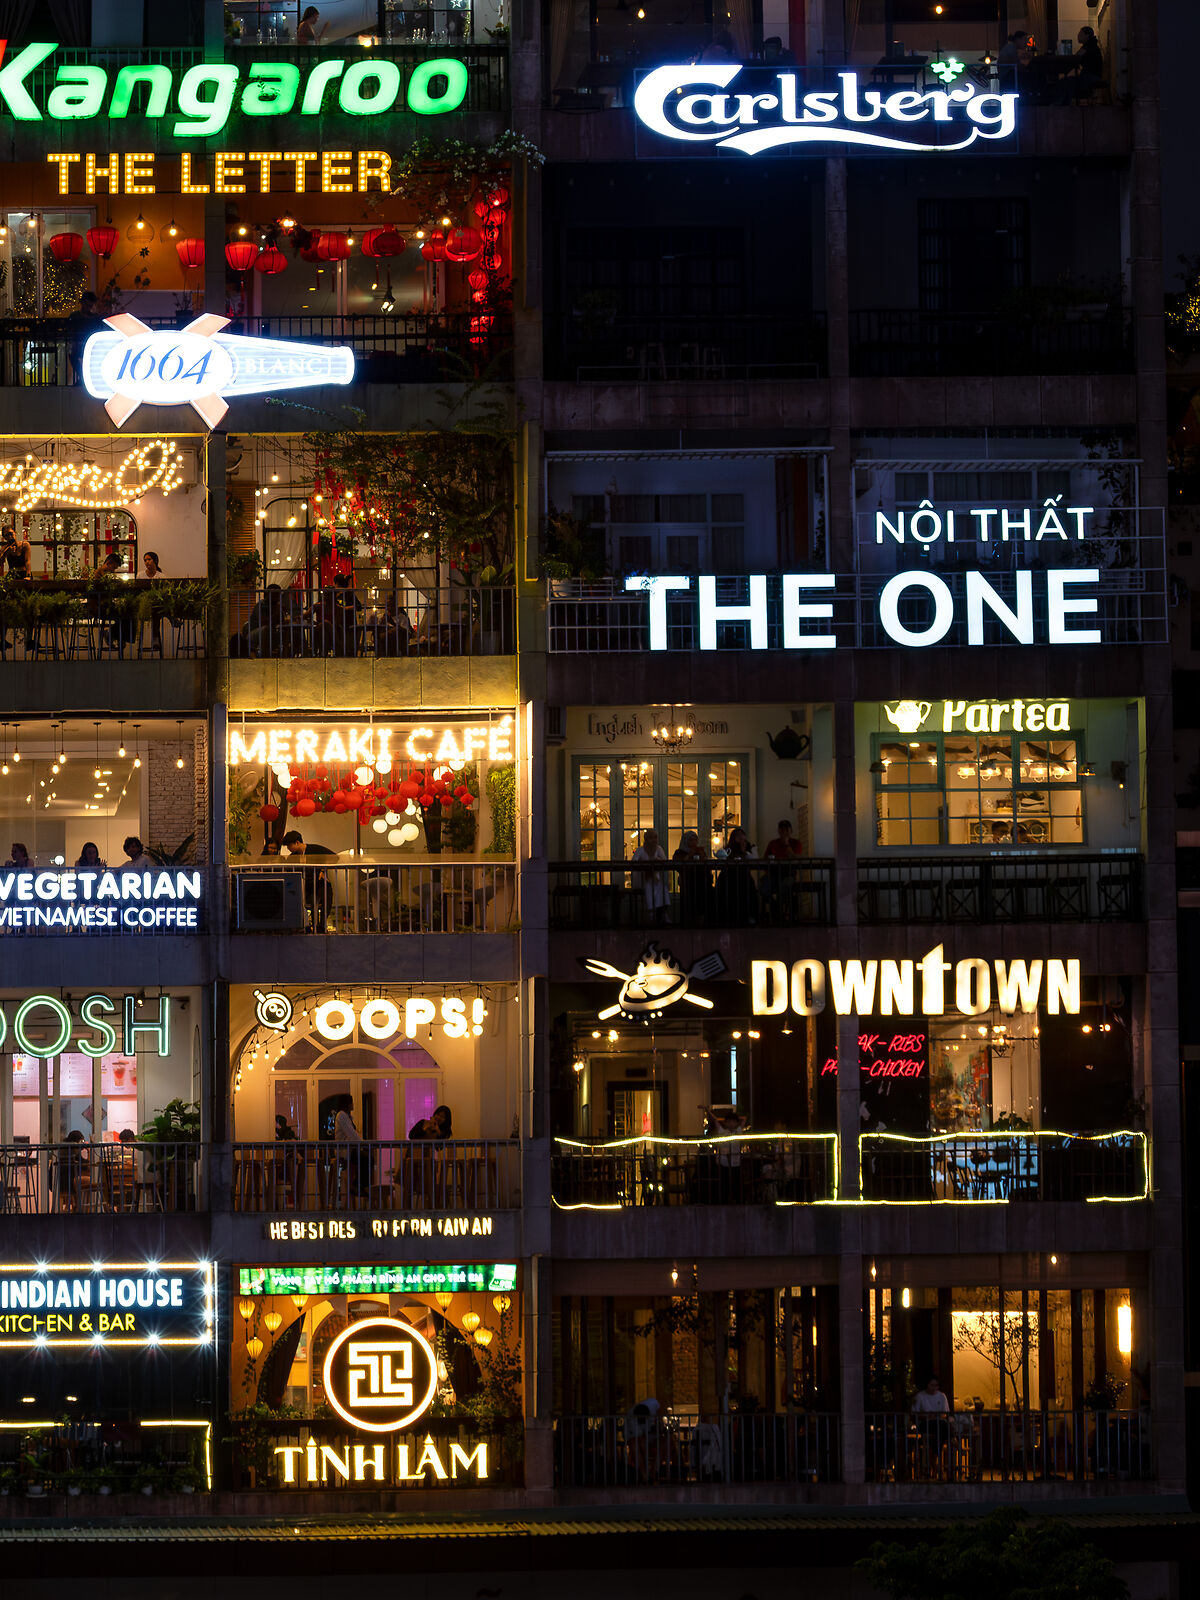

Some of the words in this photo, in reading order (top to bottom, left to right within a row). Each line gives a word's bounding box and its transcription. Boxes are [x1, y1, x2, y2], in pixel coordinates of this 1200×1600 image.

[634, 63, 1020, 155] Carlsberg
[47, 151, 157, 196] THE
[180, 150, 393, 194] LETTER
[115, 344, 214, 385] 1664
[244, 356, 325, 376] BLANC
[875, 499, 955, 551] NỘI
[969, 494, 1096, 542] THẤT
[625, 573, 838, 651] THE
[878, 568, 1102, 648] ONE
[229, 727, 394, 766] MERAKI
[406, 714, 514, 763] CAFÉ
[123, 907, 199, 927] COFFEE
[315, 997, 484, 1041] OOPS!
[1, 1279, 91, 1309] INDIAN
[99, 1278, 183, 1307] HOUSE
[78, 1313, 93, 1332] &
[99, 1313, 136, 1331] BAR
